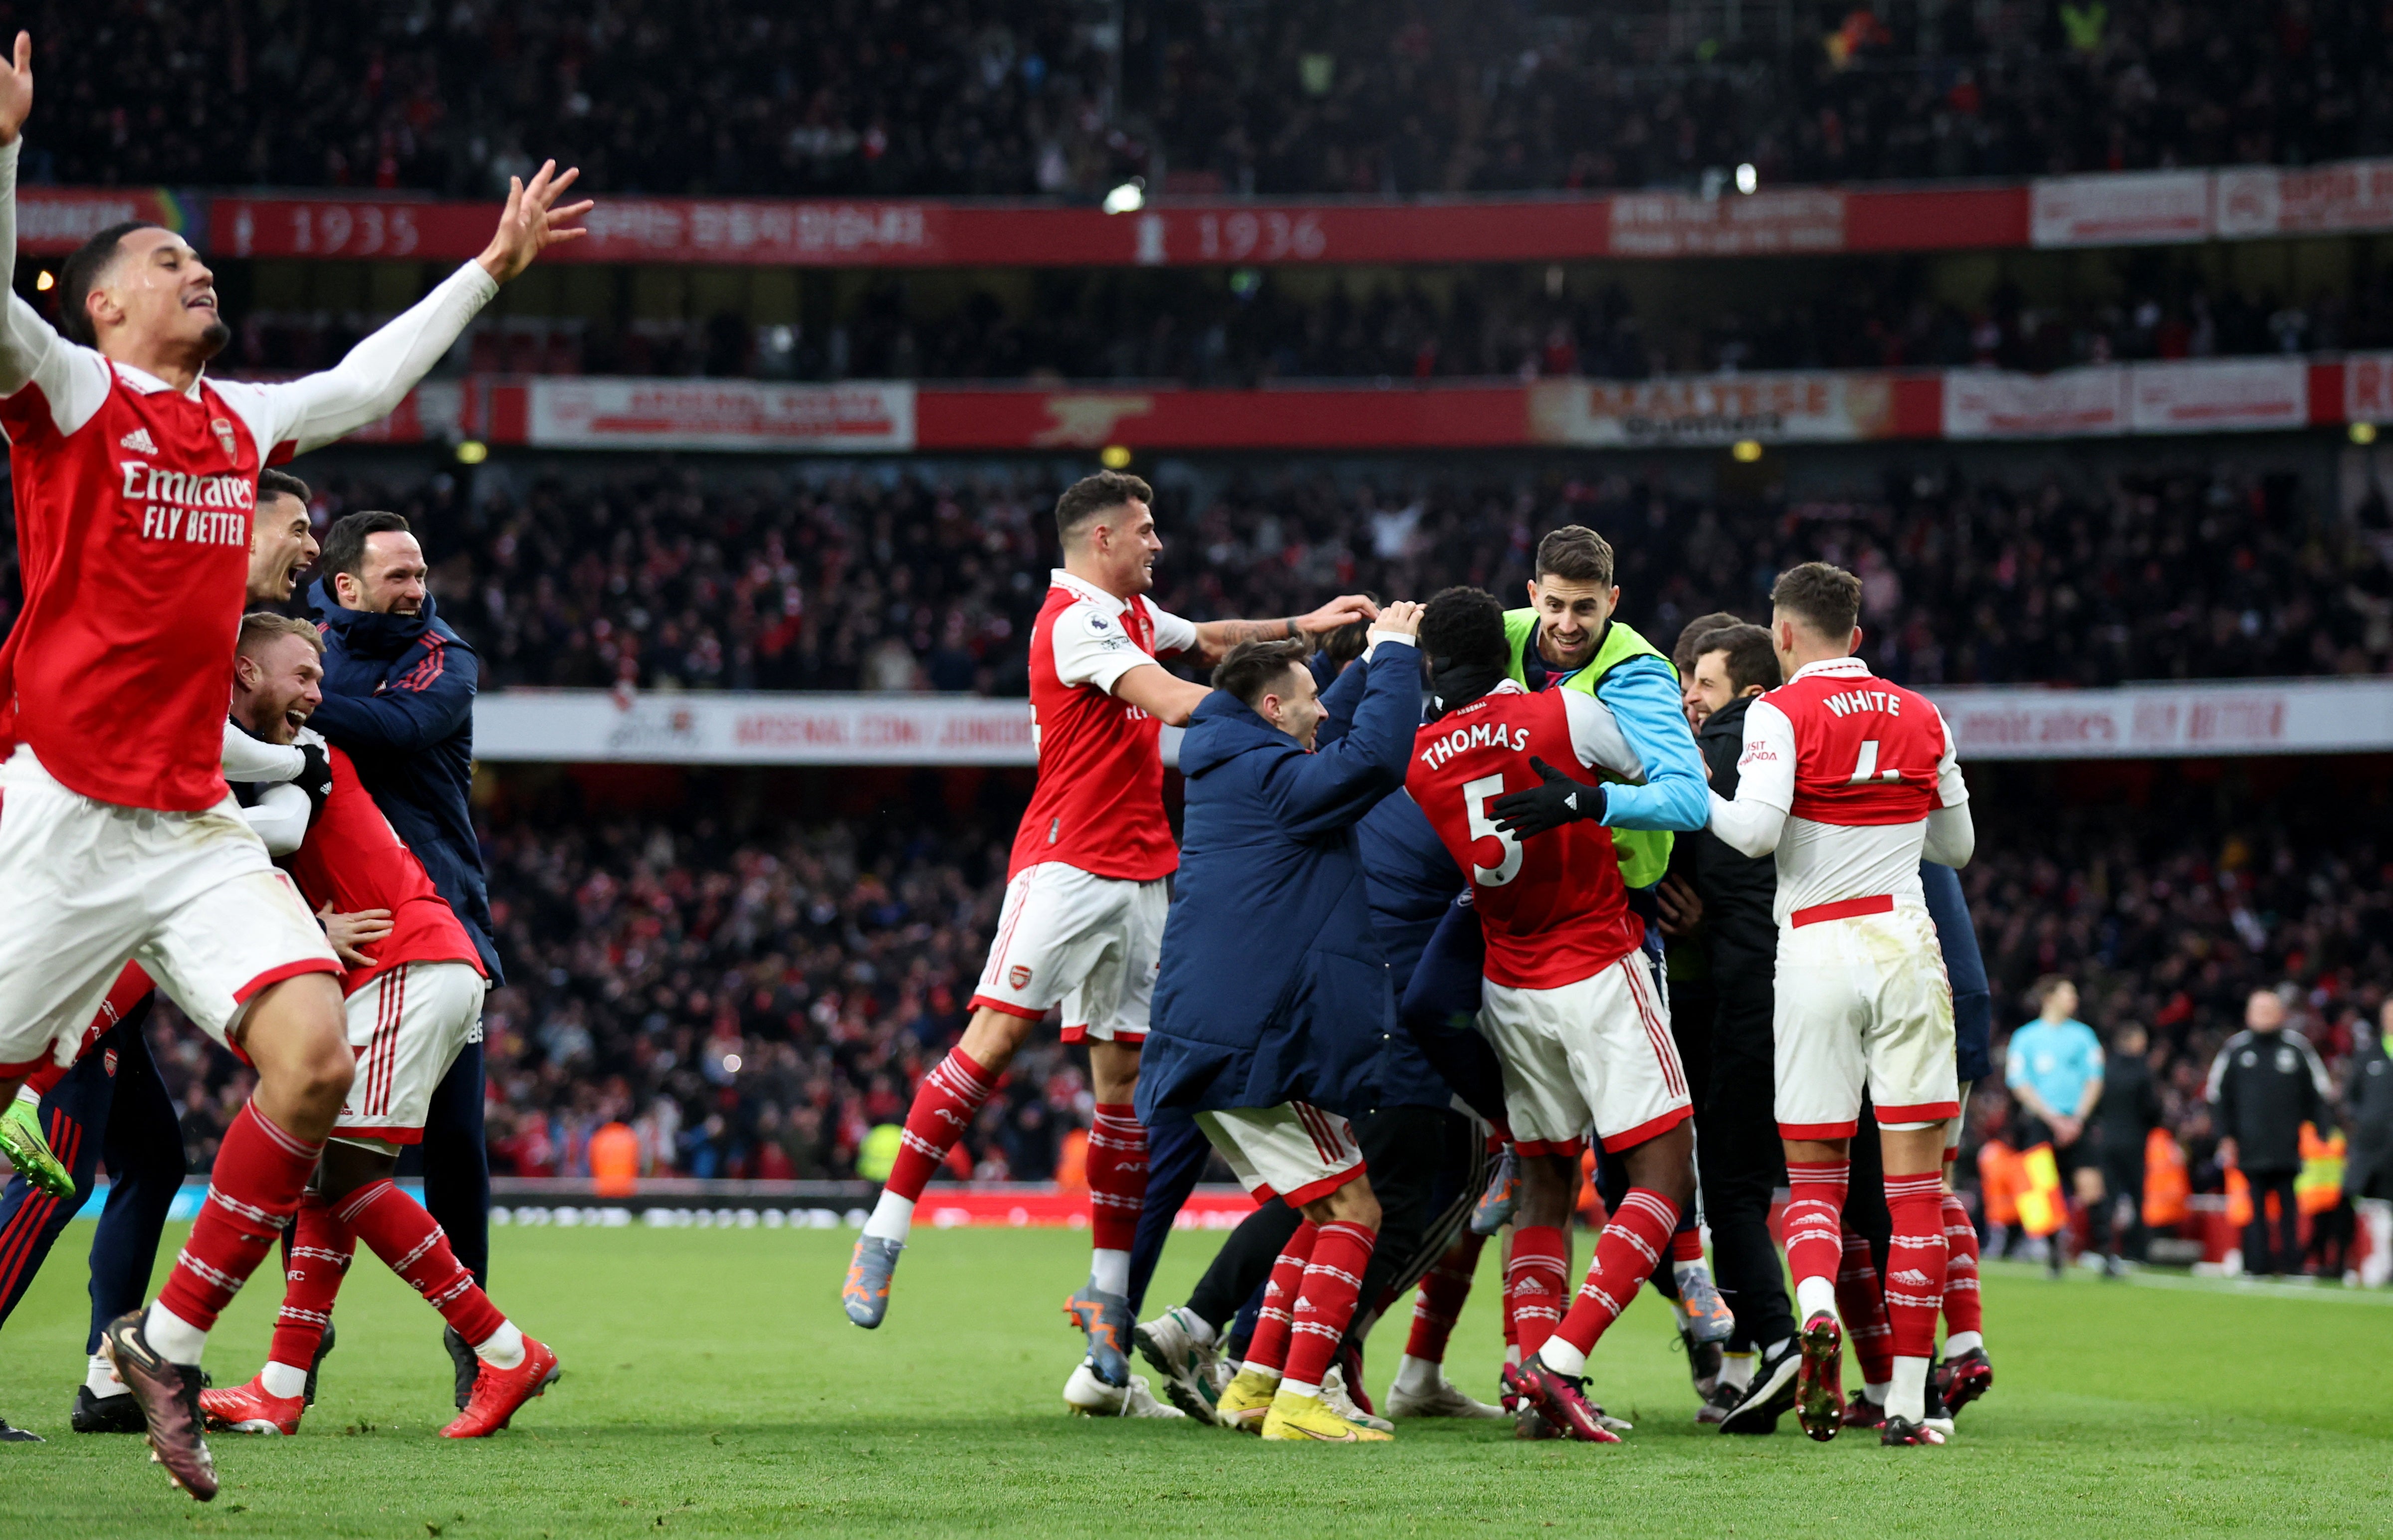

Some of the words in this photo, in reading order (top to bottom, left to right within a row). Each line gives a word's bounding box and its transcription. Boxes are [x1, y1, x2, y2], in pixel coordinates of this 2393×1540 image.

[293, 204, 418, 257] 1935
[1199, 212, 1326, 260] 1936
[120, 438, 159, 455] adidas
[120, 461, 253, 510] Emirates
[143, 506, 183, 540] FLY
[186, 510, 245, 547] BETTER
[1456, 701, 1488, 716] ARSENAL
[1822, 689, 1901, 719] WHITE
[1942, 706, 2117, 745] mirates
[1420, 723, 1530, 771] THOMAS
[1845, 740, 1905, 786] 4
[1462, 772, 1523, 887] 5
[1114, 1161, 1149, 1172] AF
[1512, 1287, 1549, 1299] adidas
